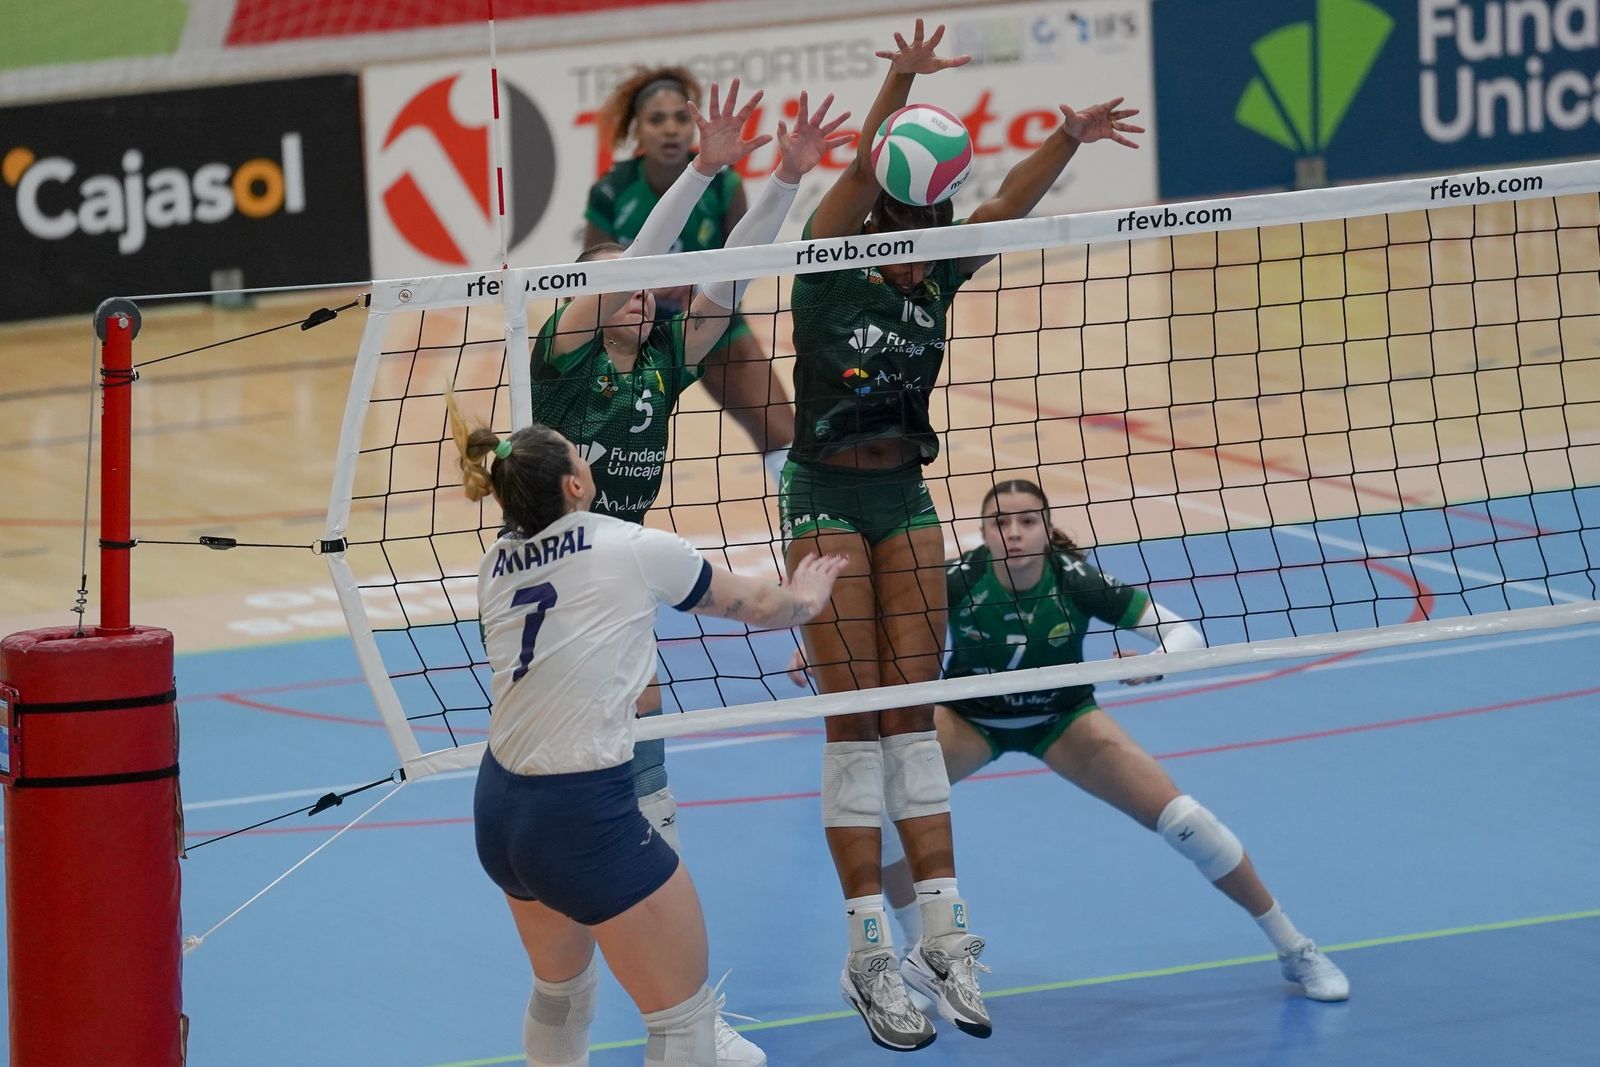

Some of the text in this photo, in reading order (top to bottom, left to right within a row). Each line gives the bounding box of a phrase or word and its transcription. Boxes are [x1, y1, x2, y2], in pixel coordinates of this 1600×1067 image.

[16, 132, 306, 255] Cajasol
[1430, 174, 1544, 200] rfevb.com
[1117, 205, 1233, 233] rfevb.com
[796, 237, 915, 266] rfevb.com
[467, 271, 588, 297] rfe.com
[629, 389, 653, 434] 5
[607, 461, 662, 481] Unicaja
[492, 526, 592, 578] AMARAL
[511, 582, 558, 683] 7
[1005, 634, 1027, 670] 7
